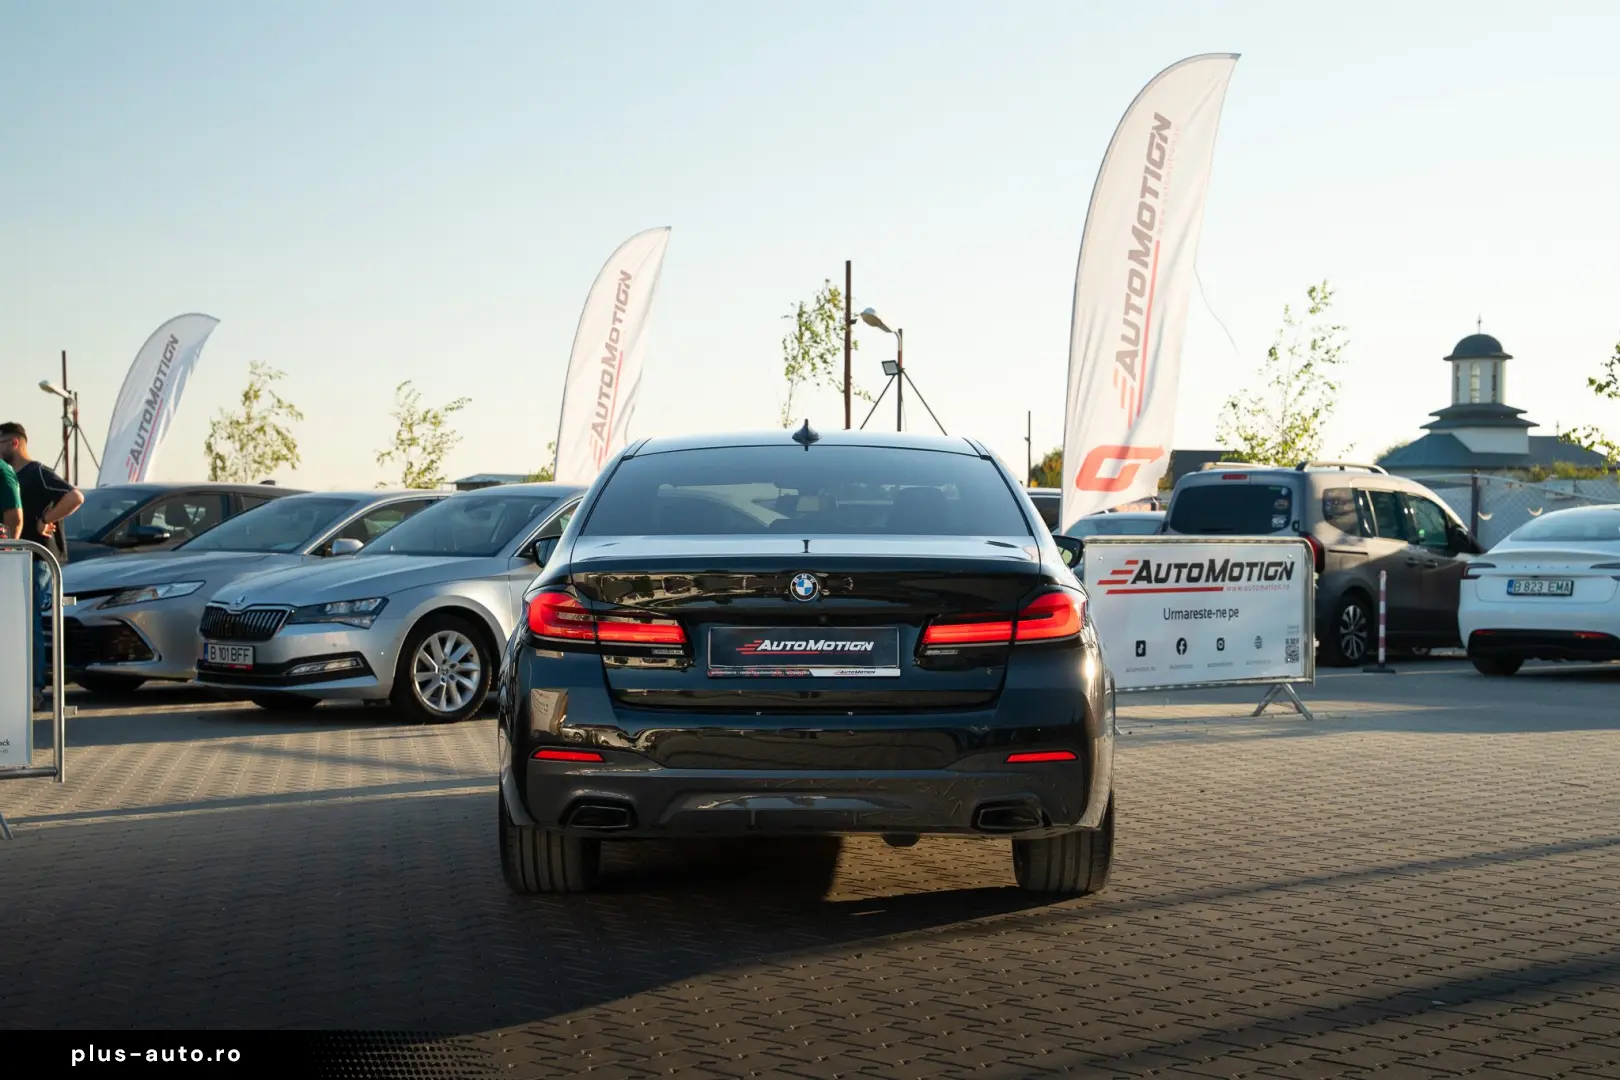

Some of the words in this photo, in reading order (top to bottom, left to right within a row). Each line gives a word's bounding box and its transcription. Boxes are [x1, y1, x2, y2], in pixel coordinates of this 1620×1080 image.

[1115, 110, 1173, 383] AUTOMOTION
[590, 268, 633, 443] AUTOMOTION
[130, 333, 180, 466] AUTOMOTION
[1130, 558, 1295, 585] AUTOMOTION
[1513, 581, 1521, 593] B
[1523, 581, 1544, 593] 823
[1547, 581, 1570, 593] EMA
[756, 639, 875, 651] AUTOMOTION
